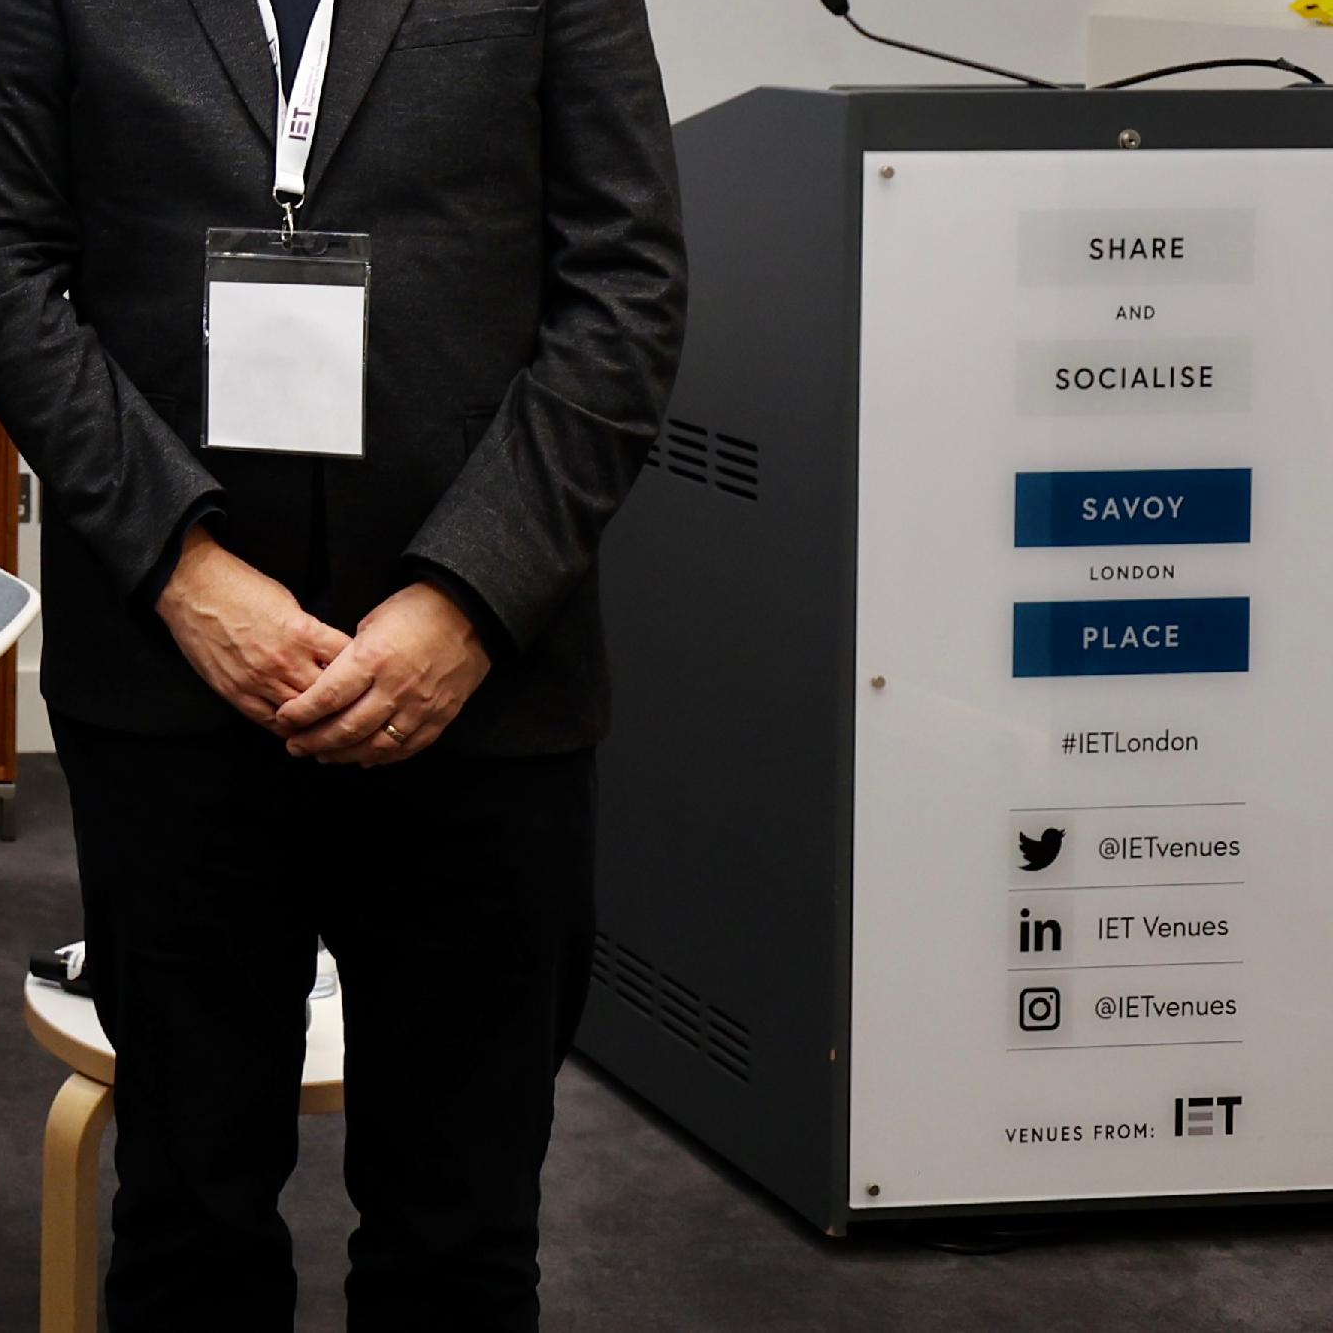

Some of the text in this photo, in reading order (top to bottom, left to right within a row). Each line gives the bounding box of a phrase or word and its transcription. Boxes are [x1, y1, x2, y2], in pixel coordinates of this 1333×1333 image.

[288, 107, 312, 141] IET
[1089, 237, 1184, 260] SHARE
[1116, 305, 1155, 320] AND
[1056, 366, 1213, 390] SOCIALISE
[1082, 496, 1184, 520] SAVOY
[1090, 565, 1175, 581] LONDON
[1083, 625, 1180, 649] PLACE
[1061, 729, 1199, 754] #IETLondon
[1098, 836, 1241, 860] @IETvenues
[1098, 916, 1229, 940] IET Venues
[1095, 995, 1237, 1019] @IETvenues
[1005, 1096, 1242, 1143] VENUES FROM: IET
